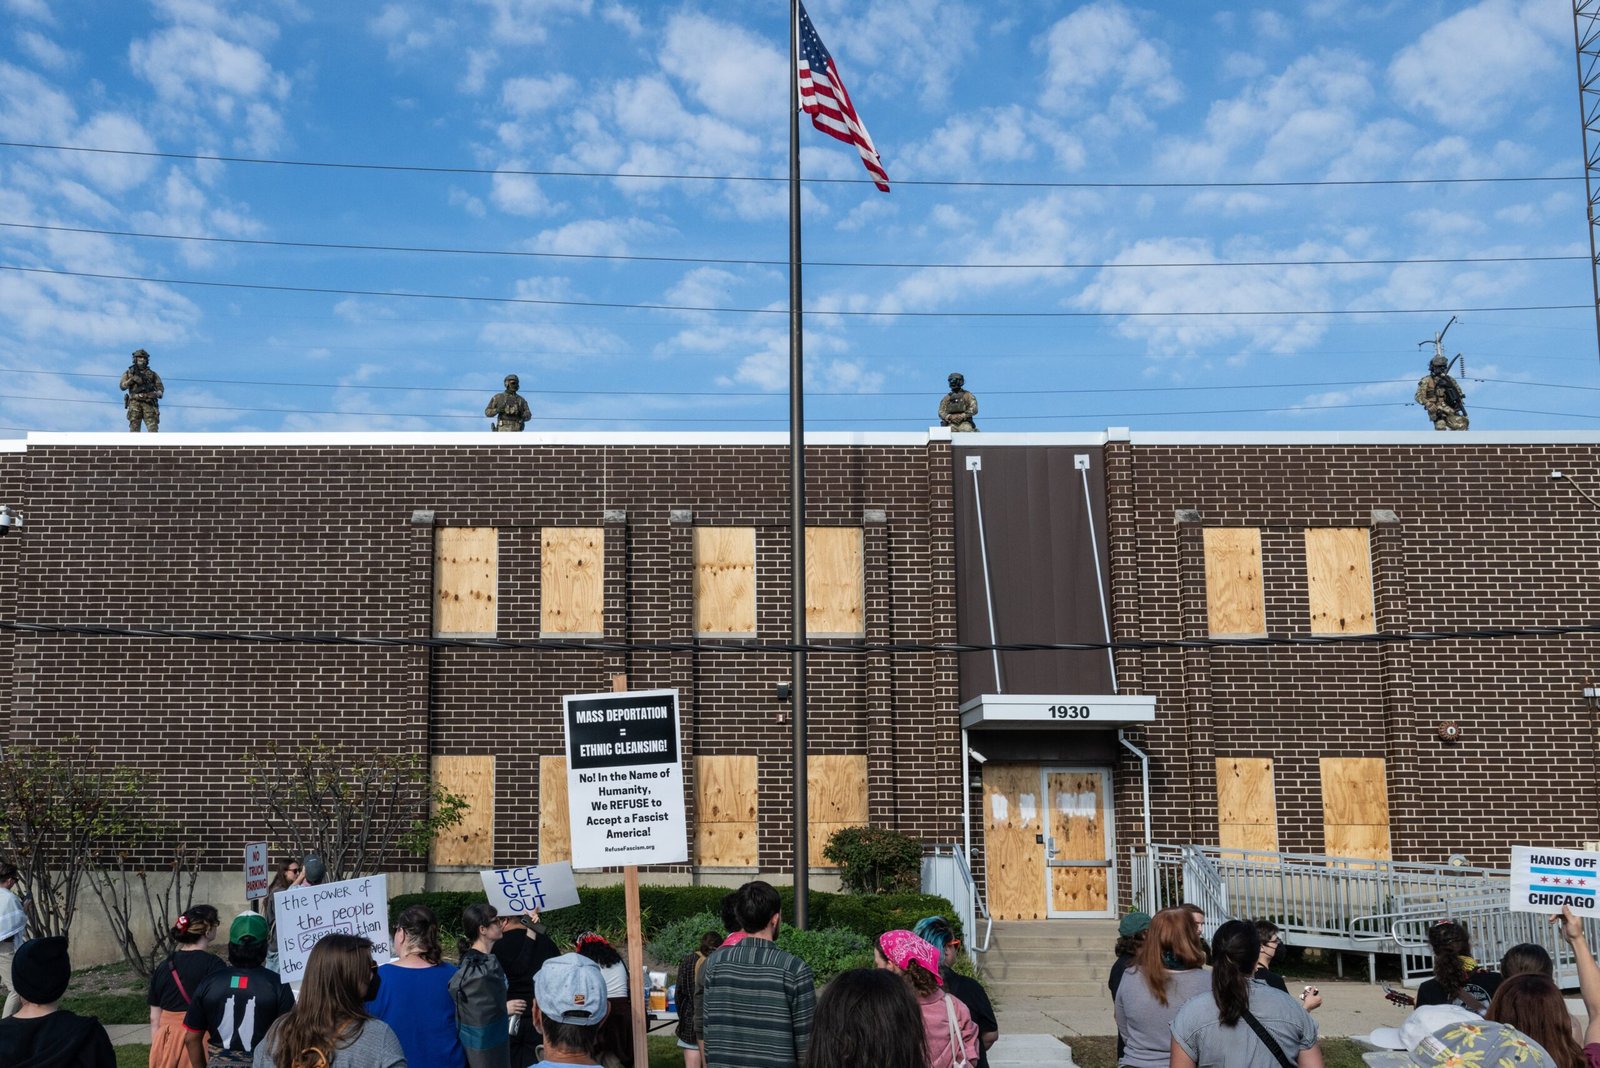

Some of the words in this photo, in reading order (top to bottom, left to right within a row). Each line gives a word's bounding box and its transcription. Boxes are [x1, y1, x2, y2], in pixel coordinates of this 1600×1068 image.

[576, 709, 604, 724] MASS
[606, 706, 668, 722] DEPORTATION
[1048, 705, 1090, 719] 1930
[580, 742, 613, 757] ETHNIC
[614, 739, 668, 755] CLEANSING!
[579, 773, 596, 783] No!
[598, 772, 608, 782] In
[609, 771, 627, 781] the
[629, 770, 658, 780] Name
[660, 768, 671, 778] of
[598, 785, 651, 797] Humanity,
[591, 801, 608, 811] We
[610, 798, 649, 810] REFUSE
[651, 798, 662, 807] to
[586, 815, 622, 826] Accept
[624, 815, 630, 823] a
[632, 812, 669, 823] Fascist
[606, 827, 651, 839] America!
[605, 844, 655, 853] RefuseFascism.org
[252, 851, 260, 862] NO
[1530, 854, 1571, 867] HANDS
[1574, 857, 1597, 868] OFF
[249, 865, 265, 876] TRUCK
[494, 866, 540, 885] ICE
[247, 878, 267, 892] PARKING
[503, 880, 542, 899] GET
[281, 895, 309, 911] the
[358, 879, 373, 897] of
[1528, 893, 1595, 909] CHICAGO
[508, 894, 547, 912] OUT
[297, 913, 324, 930] the
[332, 902, 374, 927] people
[284, 938, 295, 952] is
[356, 920, 381, 936] than
[282, 958, 303, 974] the
